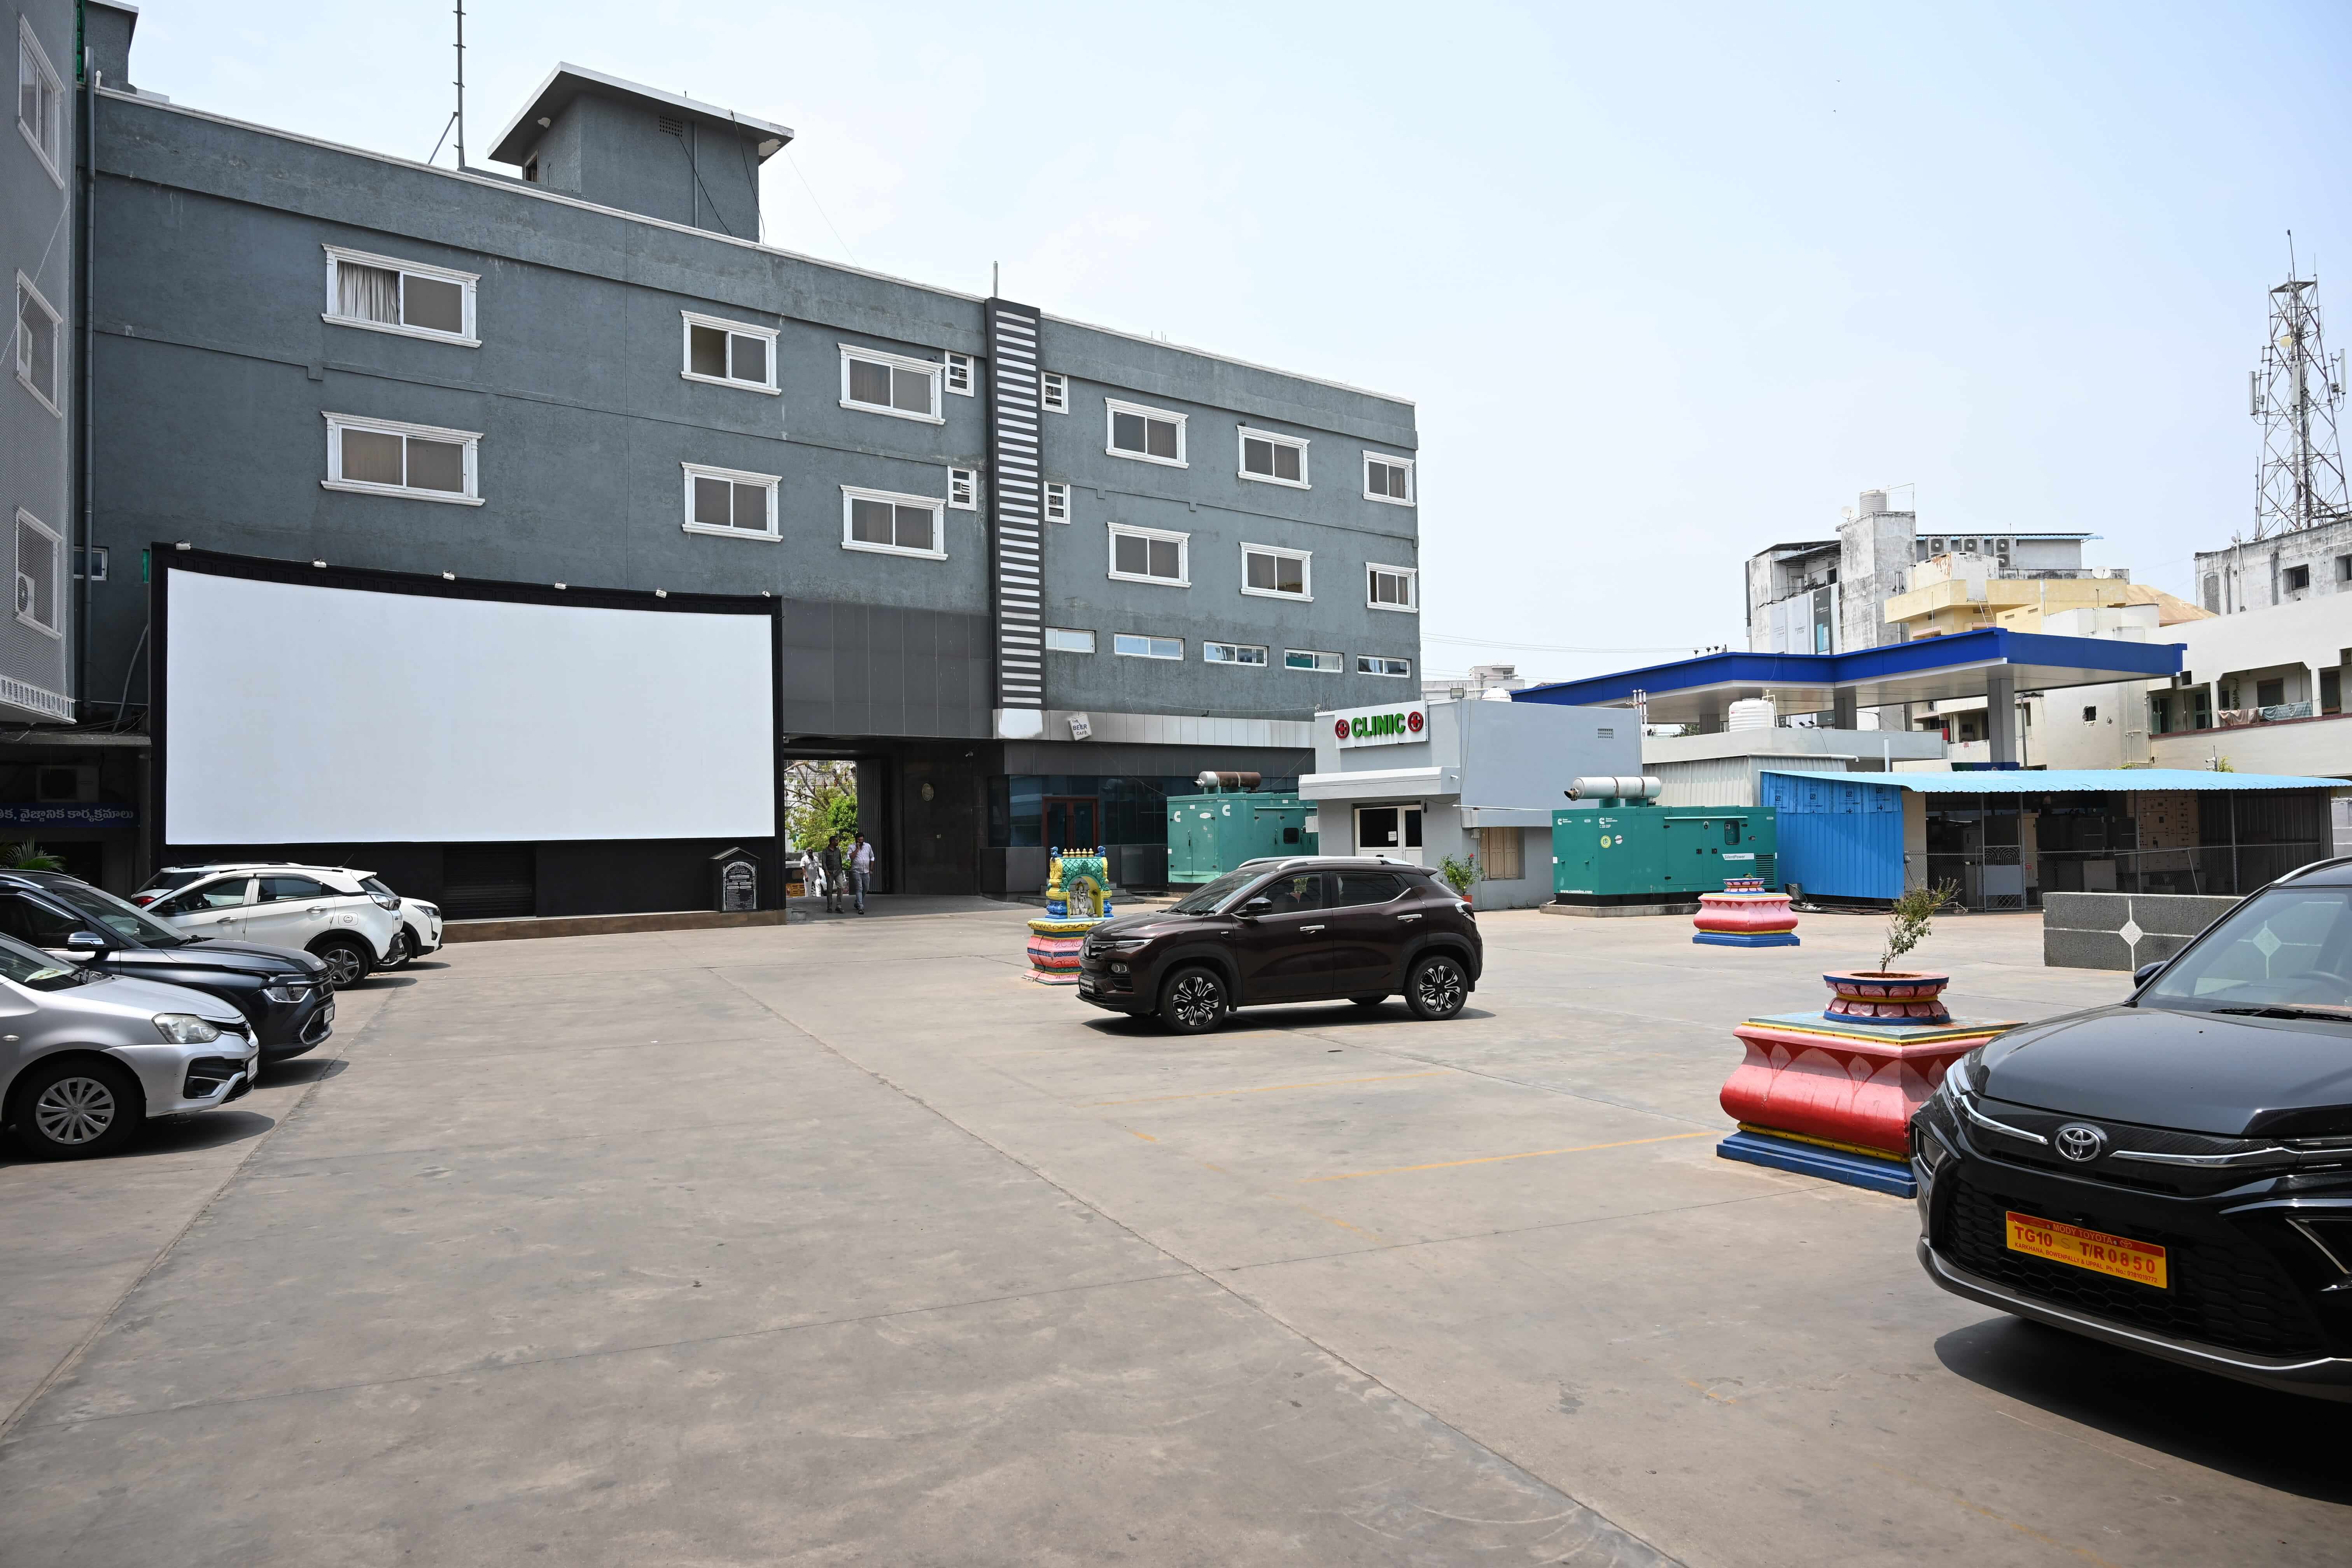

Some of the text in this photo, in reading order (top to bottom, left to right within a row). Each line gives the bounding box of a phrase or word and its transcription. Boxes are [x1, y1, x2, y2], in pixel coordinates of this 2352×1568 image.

[1351, 713, 1406, 737] CLINIC
[67, 808, 134, 822] కార్యక్రమాలు
[2014, 1226, 2053, 1247] TG10
[2053, 1224, 2076, 1236] MODY
[2079, 1230, 2112, 1244] TOYOTA
[2015, 1242, 2044, 1255] KARKHANA,
[2046, 1250, 2079, 1263] BOWENPALLY
[2086, 1260, 2103, 1269] UPPAL
[2128, 1270, 2158, 1283] 9281019772
